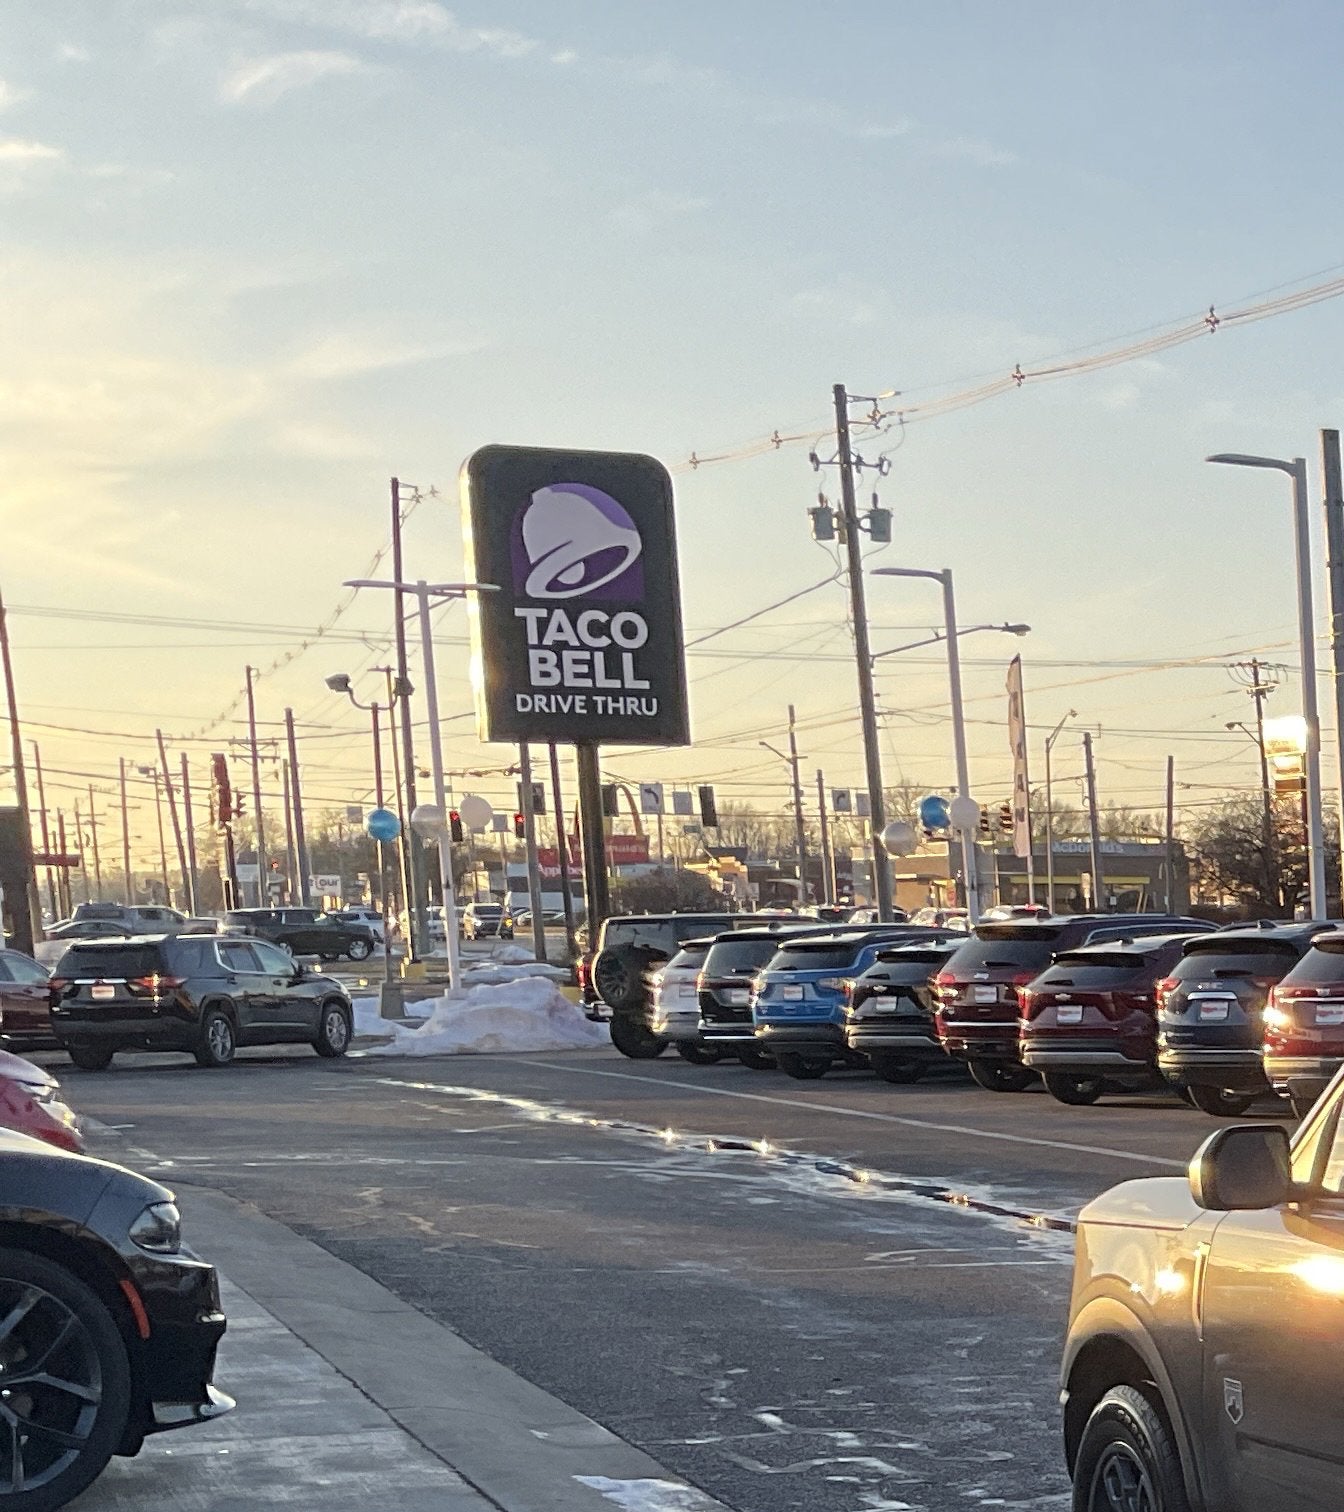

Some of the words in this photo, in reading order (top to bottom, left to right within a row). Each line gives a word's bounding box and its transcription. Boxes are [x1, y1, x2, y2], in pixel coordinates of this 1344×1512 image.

[514, 607, 649, 649] TACO
[528, 648, 651, 690] BELL
[515, 693, 588, 715] DRIVE
[592, 696, 658, 717] THRU
